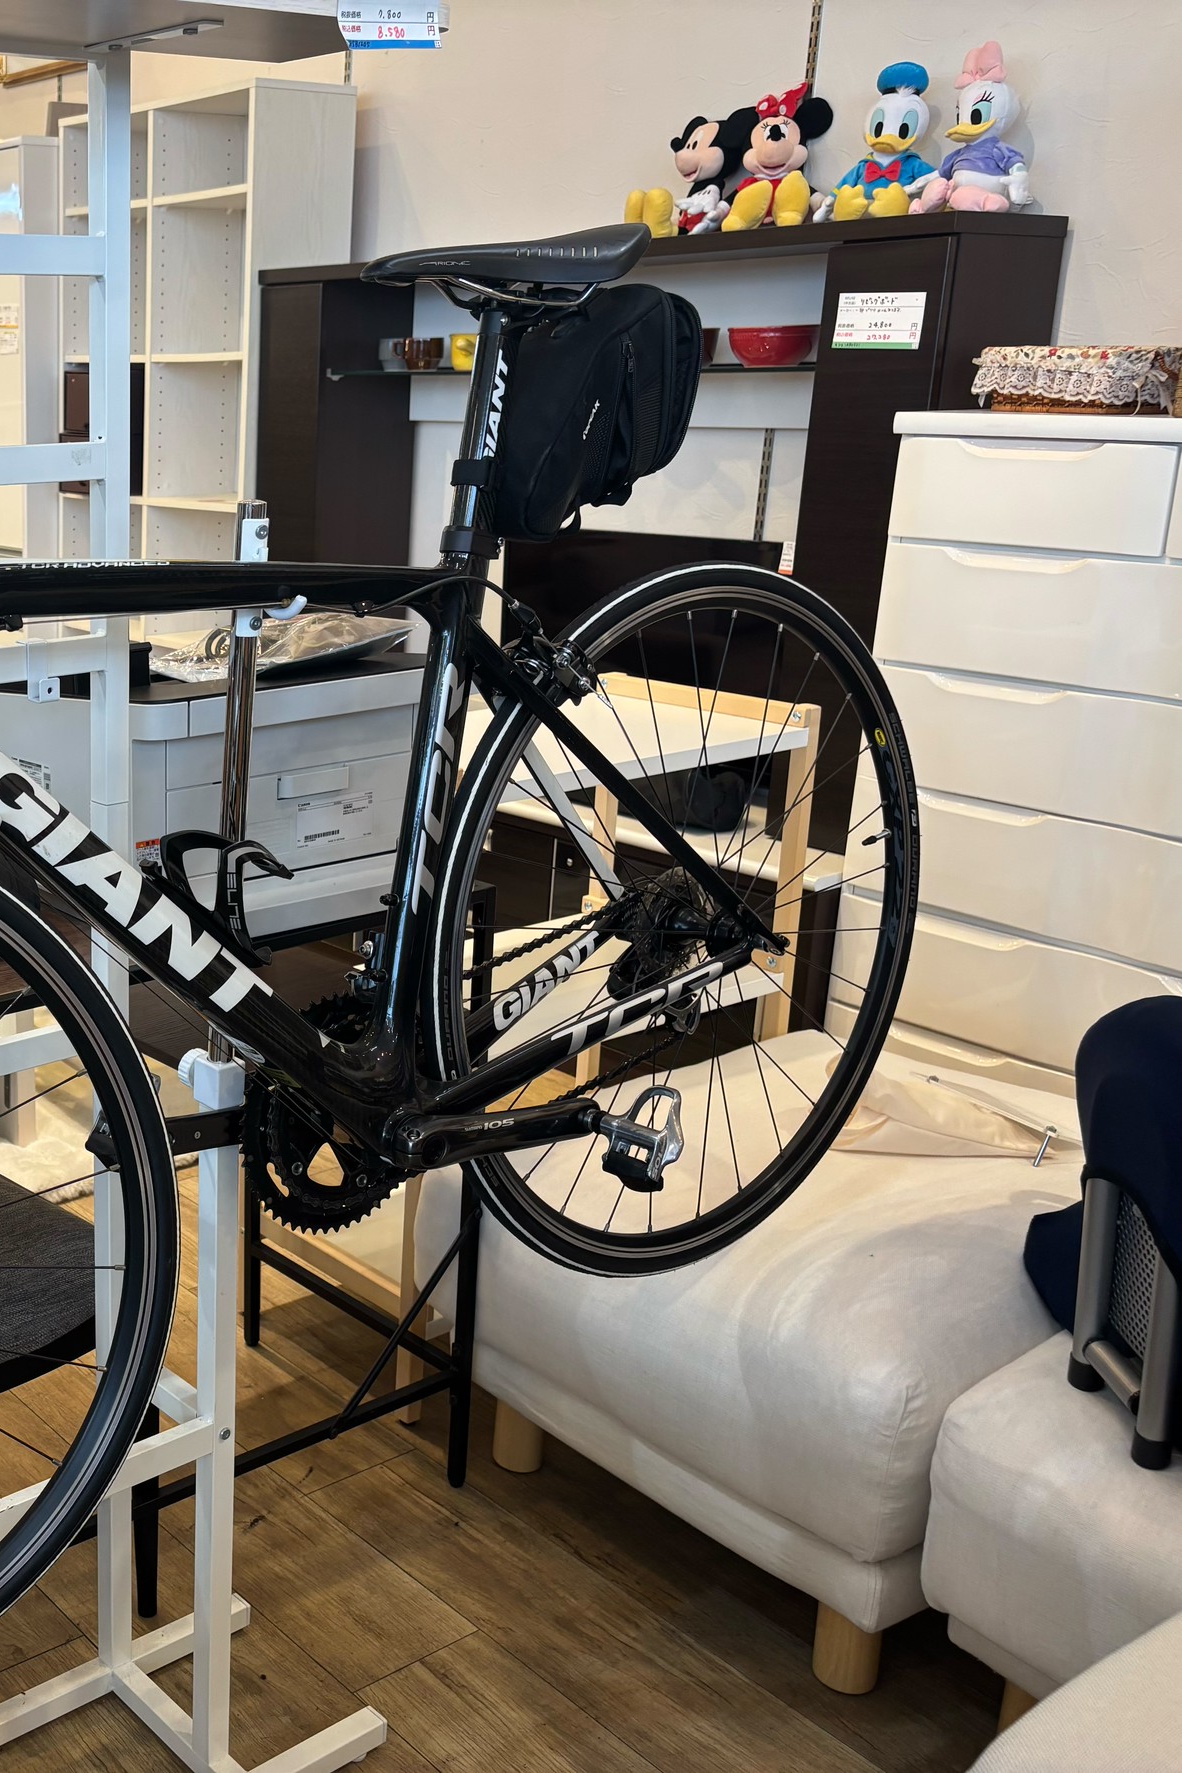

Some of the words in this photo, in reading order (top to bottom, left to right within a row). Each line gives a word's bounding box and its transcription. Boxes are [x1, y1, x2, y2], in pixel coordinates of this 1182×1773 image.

[341, 25, 362, 33] 税込価格
[427, 25, 436, 36] 円
[426, 12, 435, 23] 円
[909, 332, 917, 340] 円
[911, 322, 918, 330] 円
[482, 349, 508, 457] IANT
[412, 662, 466, 915] TCR
[226, 873, 242, 930] ELITE
[493, 931, 599, 1031] GIANT
[550, 961, 724, 1054] TCR
[483, 1117, 515, 1131] 105
